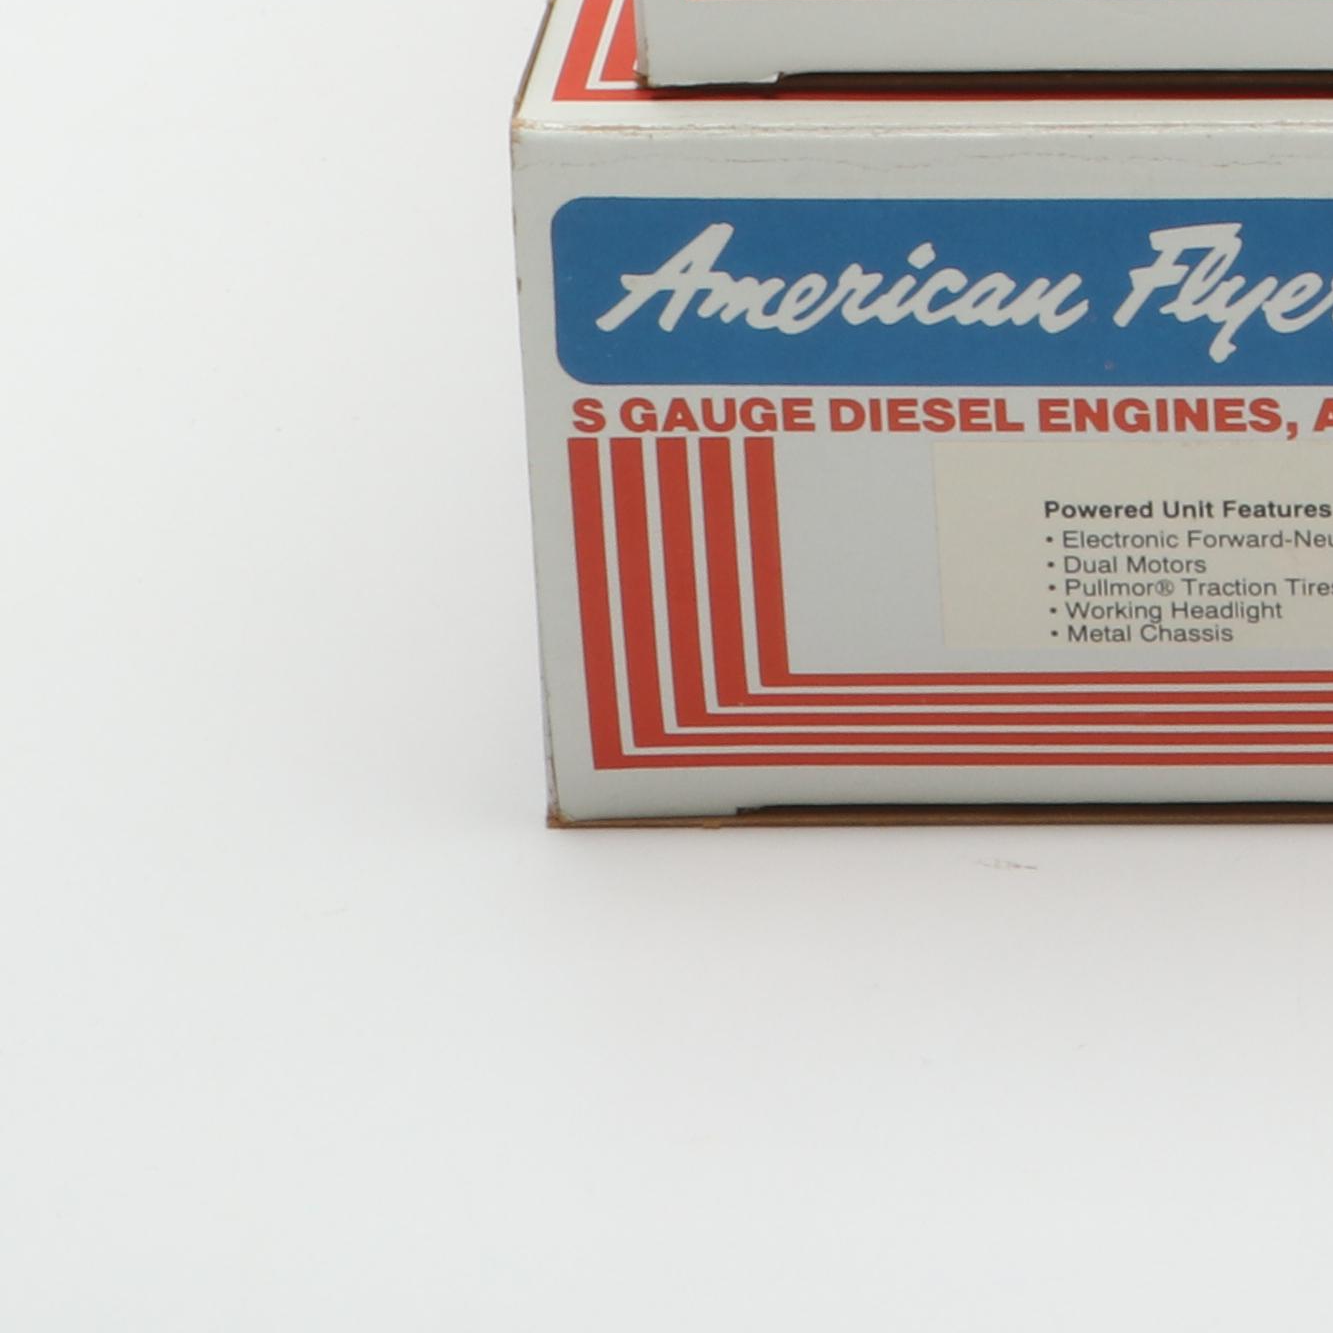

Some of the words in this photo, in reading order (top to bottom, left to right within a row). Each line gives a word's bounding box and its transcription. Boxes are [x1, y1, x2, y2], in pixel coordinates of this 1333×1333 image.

[595, 222, 1090, 335] American
[570, 397, 607, 434] S
[618, 397, 818, 434] GAUGE
[830, 398, 1028, 434] DIESEL
[1039, 398, 1300, 441] ENGINES,
[1045, 501, 1154, 520] Powered
[1163, 501, 1214, 520] Unit
[1063, 531, 1179, 550] Electronic
[1065, 556, 1119, 575] Dual
[1127, 556, 1208, 575] Motors
[1182, 579, 1278, 598] Traction
[1066, 602, 1164, 625] Working
[1172, 602, 1284, 624] Headlight
[1068, 625, 1133, 644] Metal
[1141, 625, 1235, 644] Chassis
